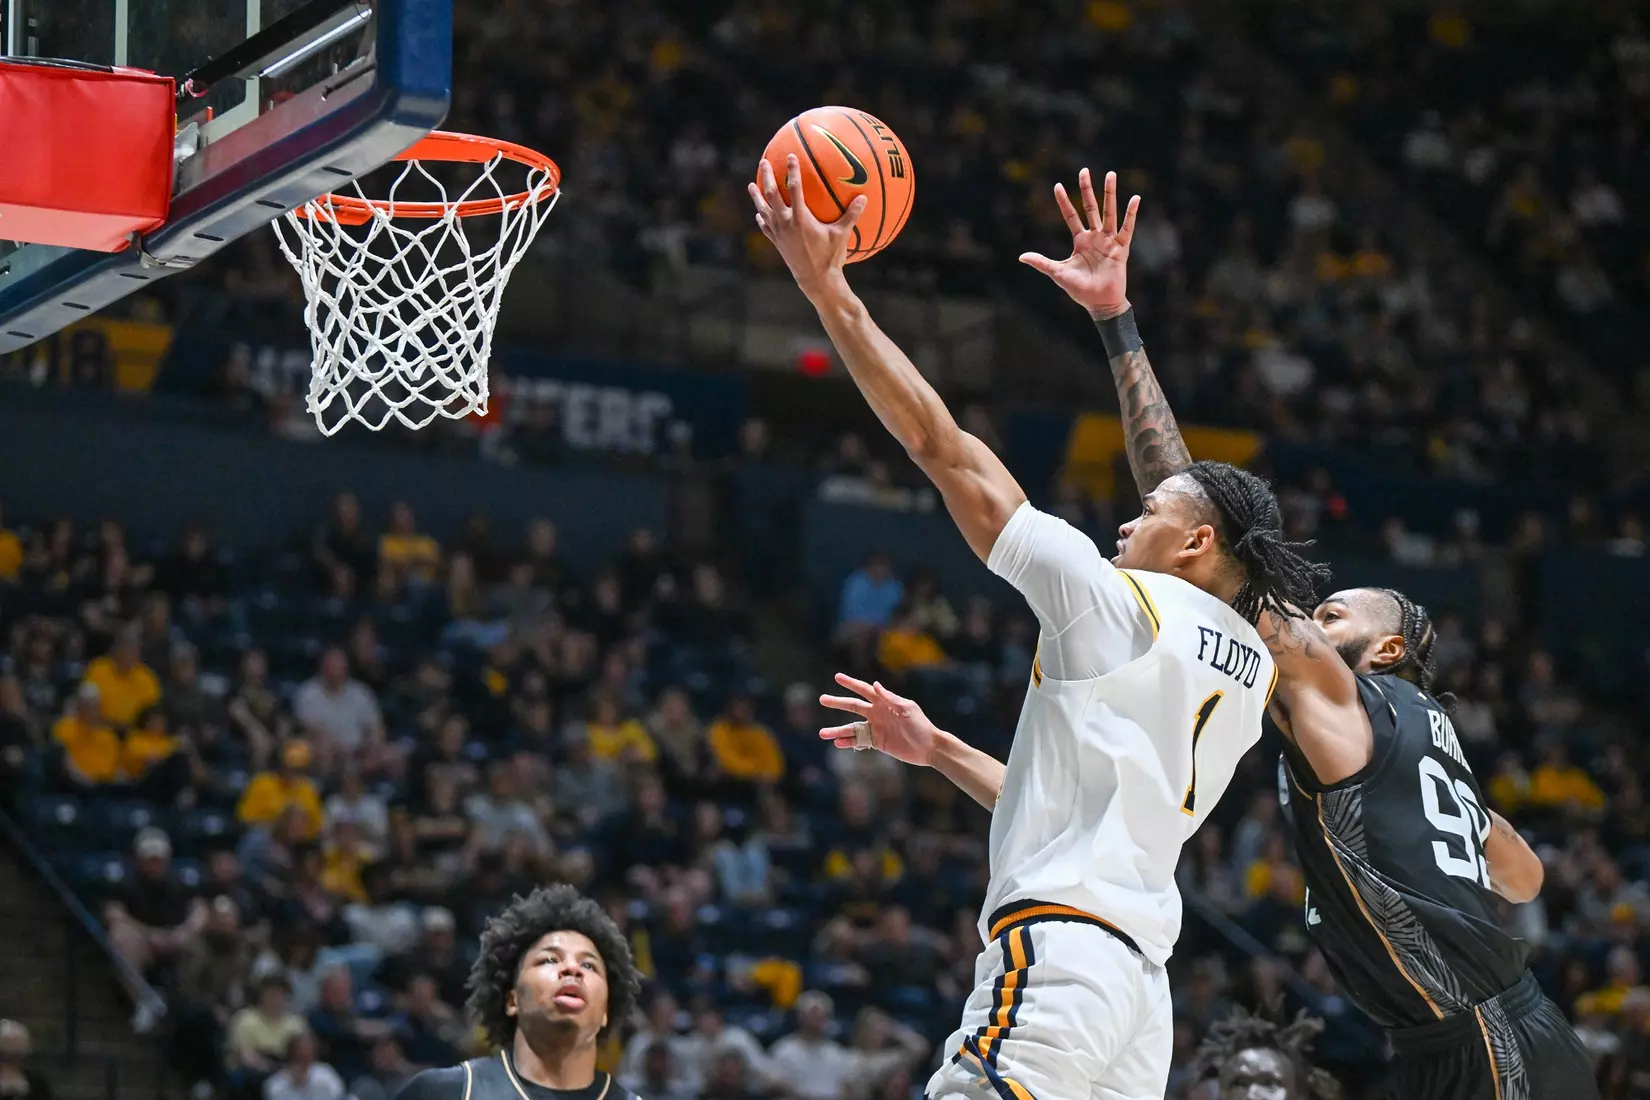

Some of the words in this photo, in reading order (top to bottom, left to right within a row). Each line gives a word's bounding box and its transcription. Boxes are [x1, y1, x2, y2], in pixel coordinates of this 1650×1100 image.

[859, 113, 905, 179] ELITE
[1197, 625, 1262, 689] FLOYD
[1180, 689, 1225, 817] 1
